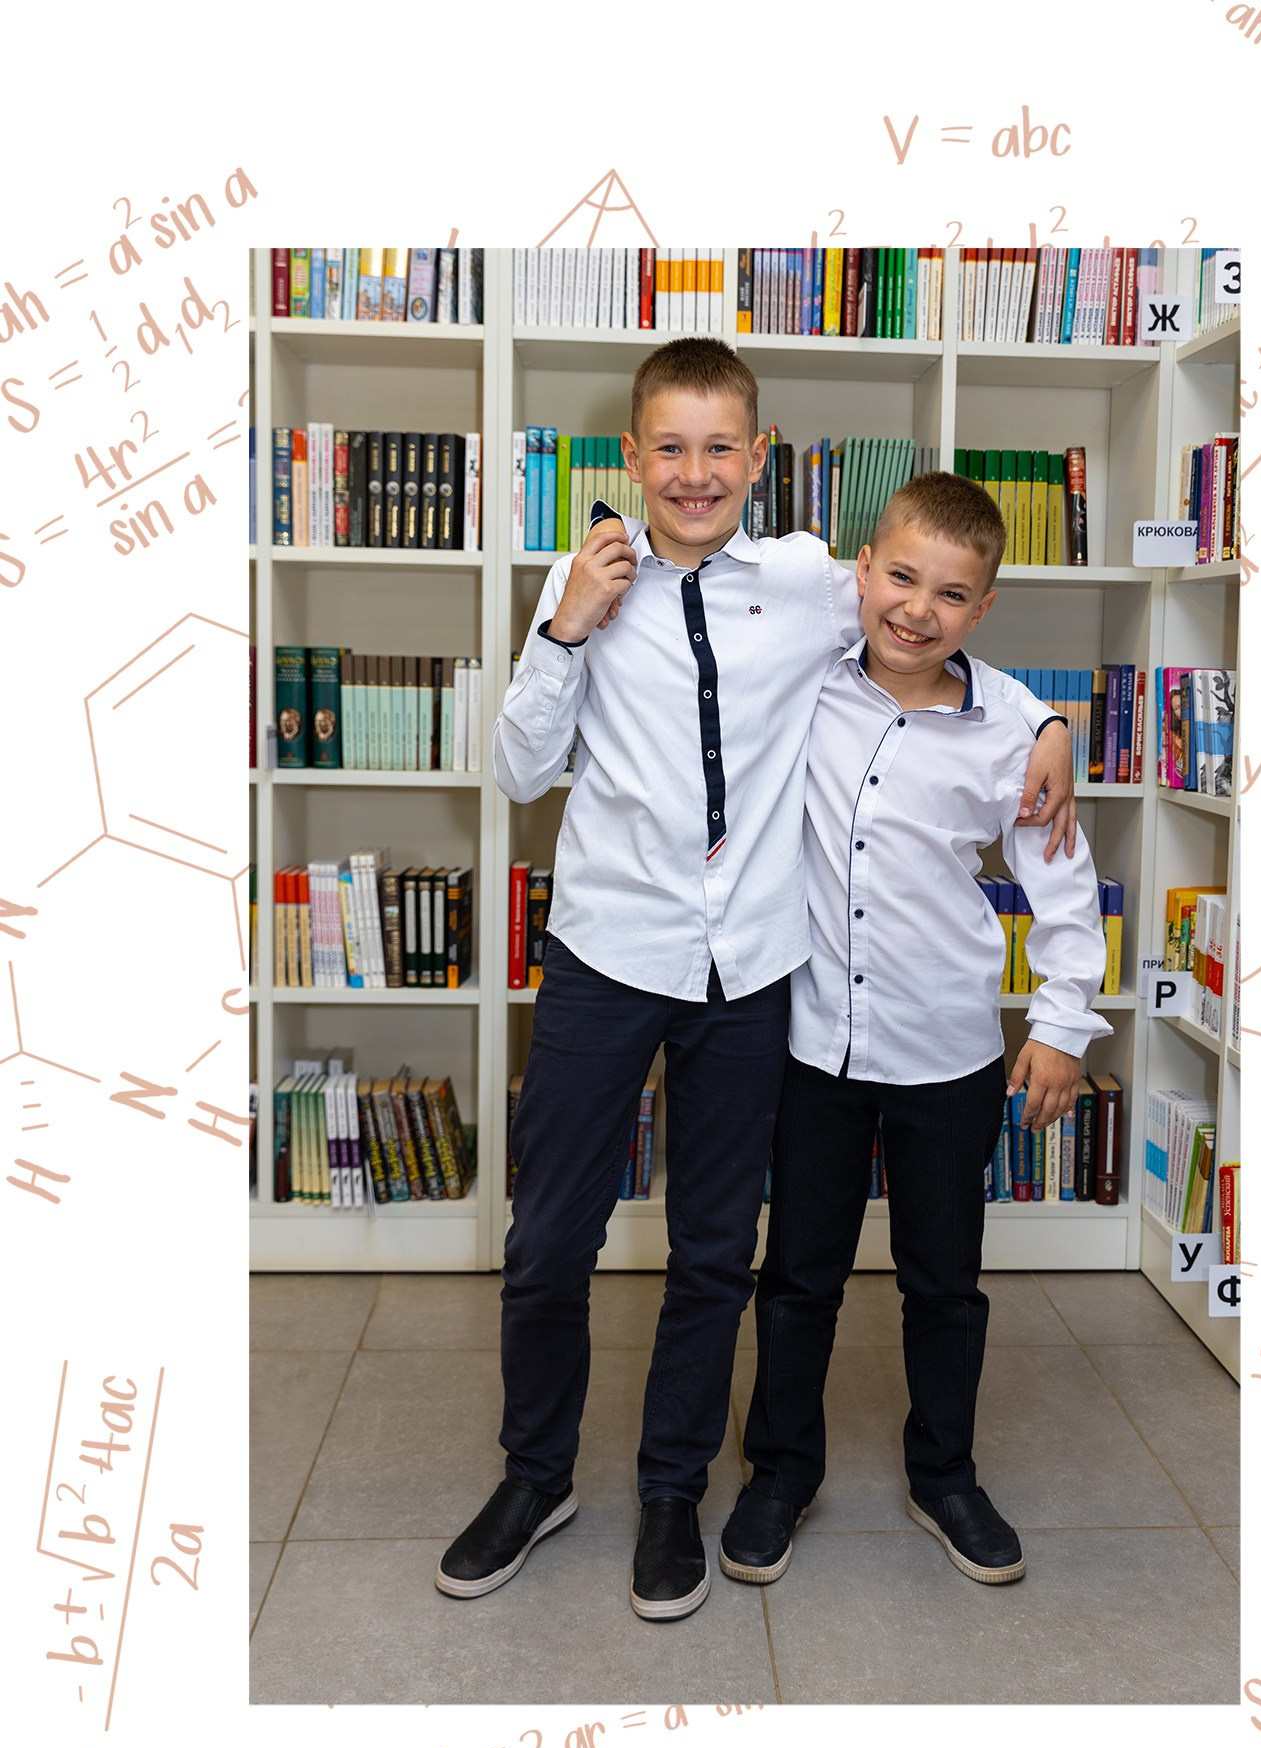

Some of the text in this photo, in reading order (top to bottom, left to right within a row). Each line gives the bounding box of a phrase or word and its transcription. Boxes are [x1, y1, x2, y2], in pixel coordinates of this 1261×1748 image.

[1147, 303, 1180, 332] Ж
[1155, 981, 1177, 1009] Р
[1178, 1243, 1204, 1273] У
